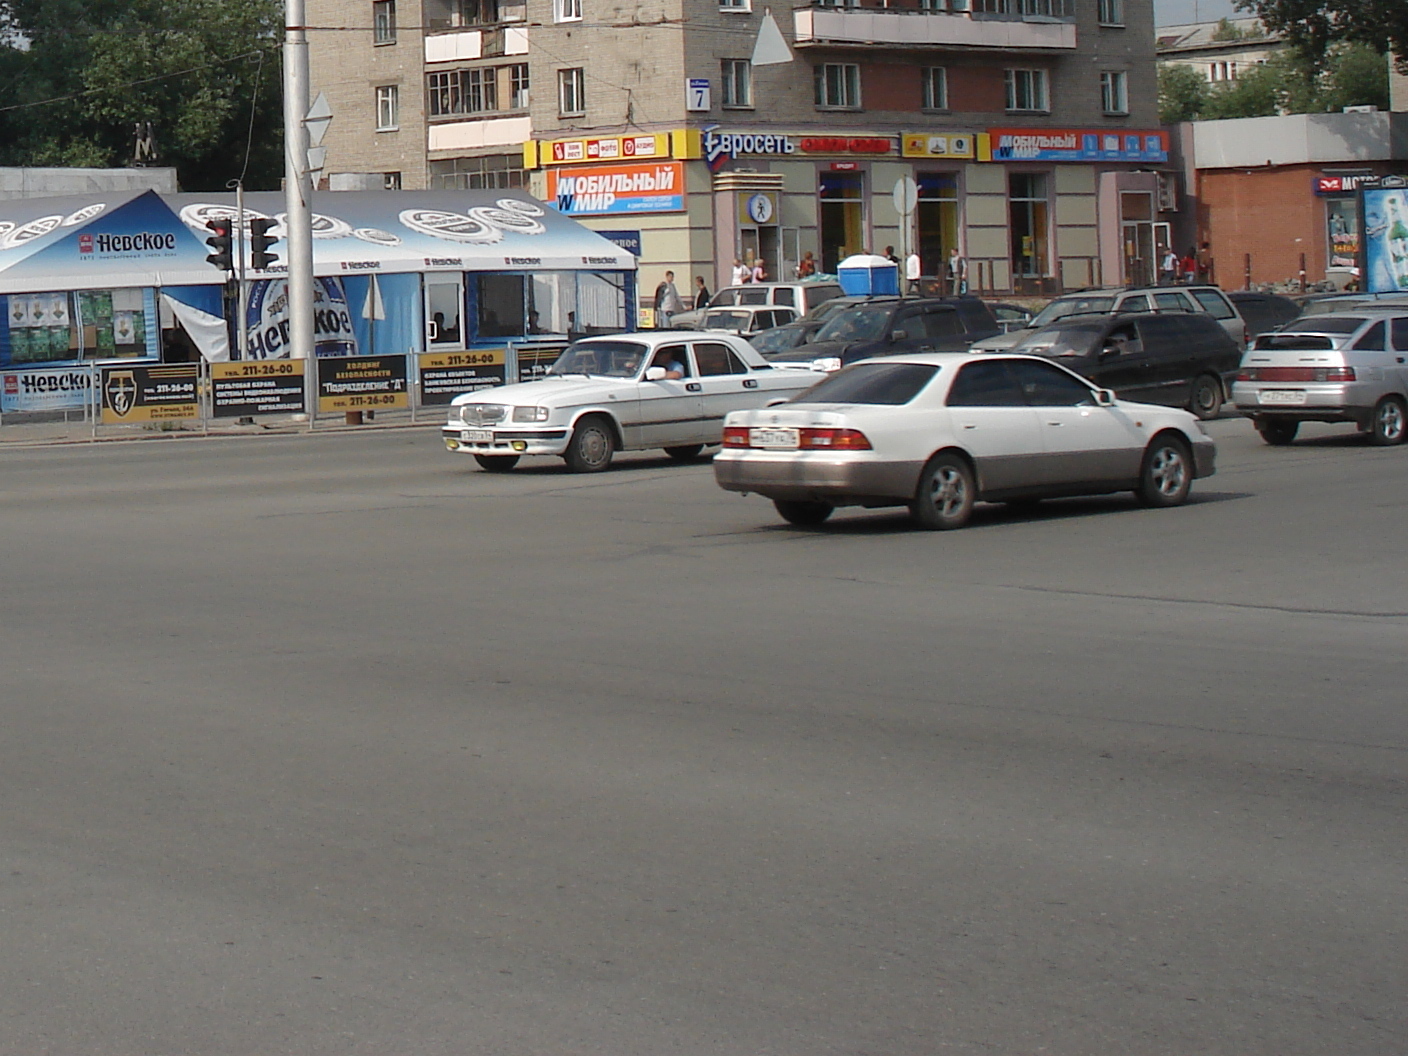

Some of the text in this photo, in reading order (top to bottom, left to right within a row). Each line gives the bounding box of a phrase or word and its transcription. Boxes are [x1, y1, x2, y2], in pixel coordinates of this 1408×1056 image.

[696, 90, 703, 108] 7
[1000, 133, 1077, 149] МОБИЛЬНЫЙ
[1012, 147, 1040, 158] МИР
[557, 166, 674, 195] МОБИЛЬНЫЙ
[574, 193, 615, 212] МИР
[96, 232, 175, 252] Невское
[448, 354, 493, 365] 211-26-00
[242, 365, 293, 375] 211-26-00
[156, 383, 194, 393] 211-26-00
[350, 395, 395, 406] 211-26-00
